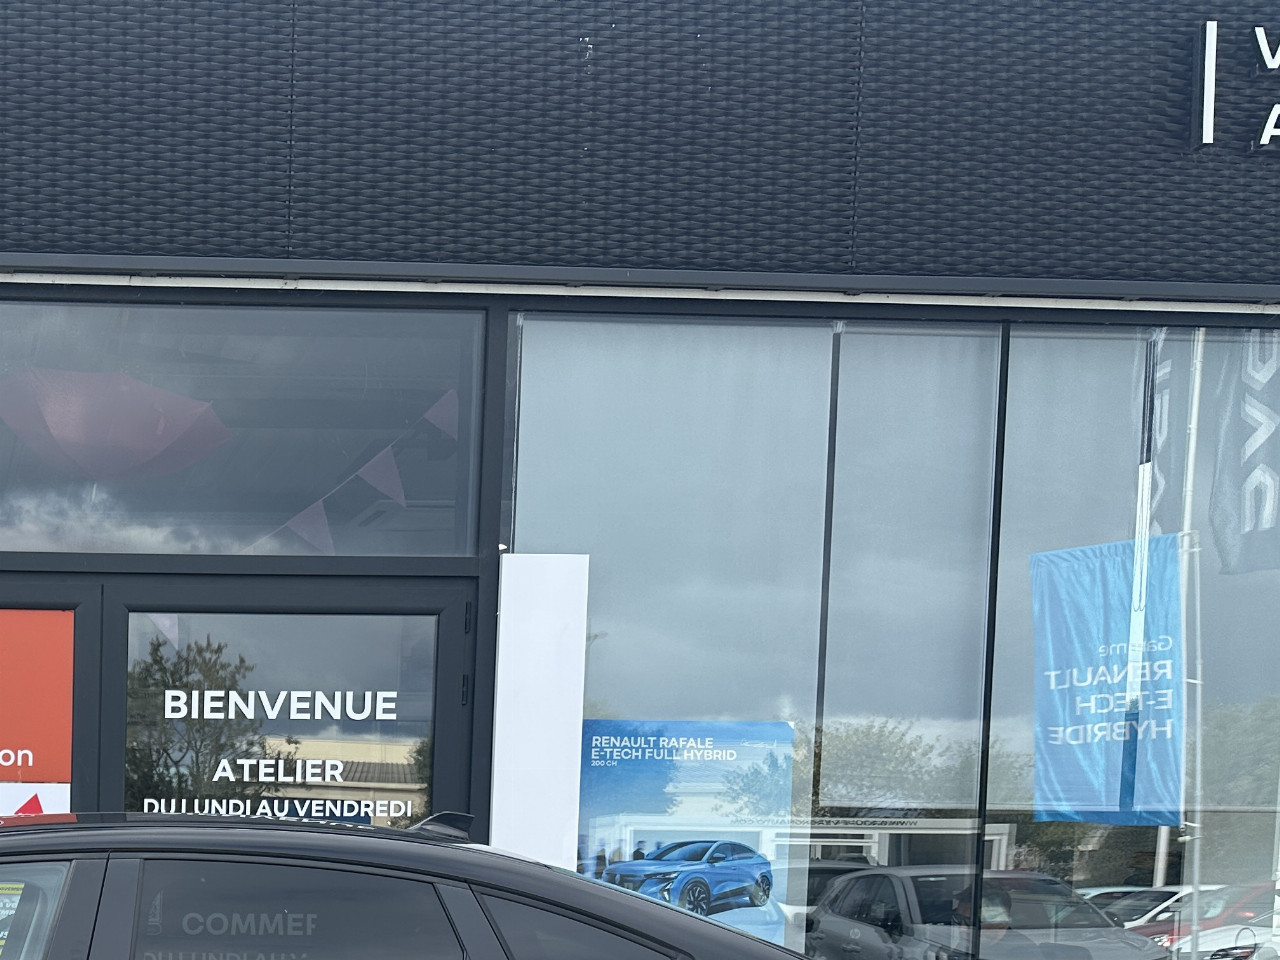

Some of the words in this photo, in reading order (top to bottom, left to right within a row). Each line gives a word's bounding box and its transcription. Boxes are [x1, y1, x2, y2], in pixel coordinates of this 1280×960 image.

[164, 690, 398, 720] BIENVENUE
[592, 736, 657, 748] RENAULT
[659, 737, 713, 748] RAFALE
[591, 748, 642, 760] E-TECH
[645, 749, 680, 760] FULL
[684, 750, 737, 761] HYBRID
[212, 759, 344, 782] ATELIER
[144, 799, 176, 814] DU
[181, 799, 251, 817] LUNDI
[256, 799, 290, 817] AU
[293, 800, 412, 817] VENDREDI
